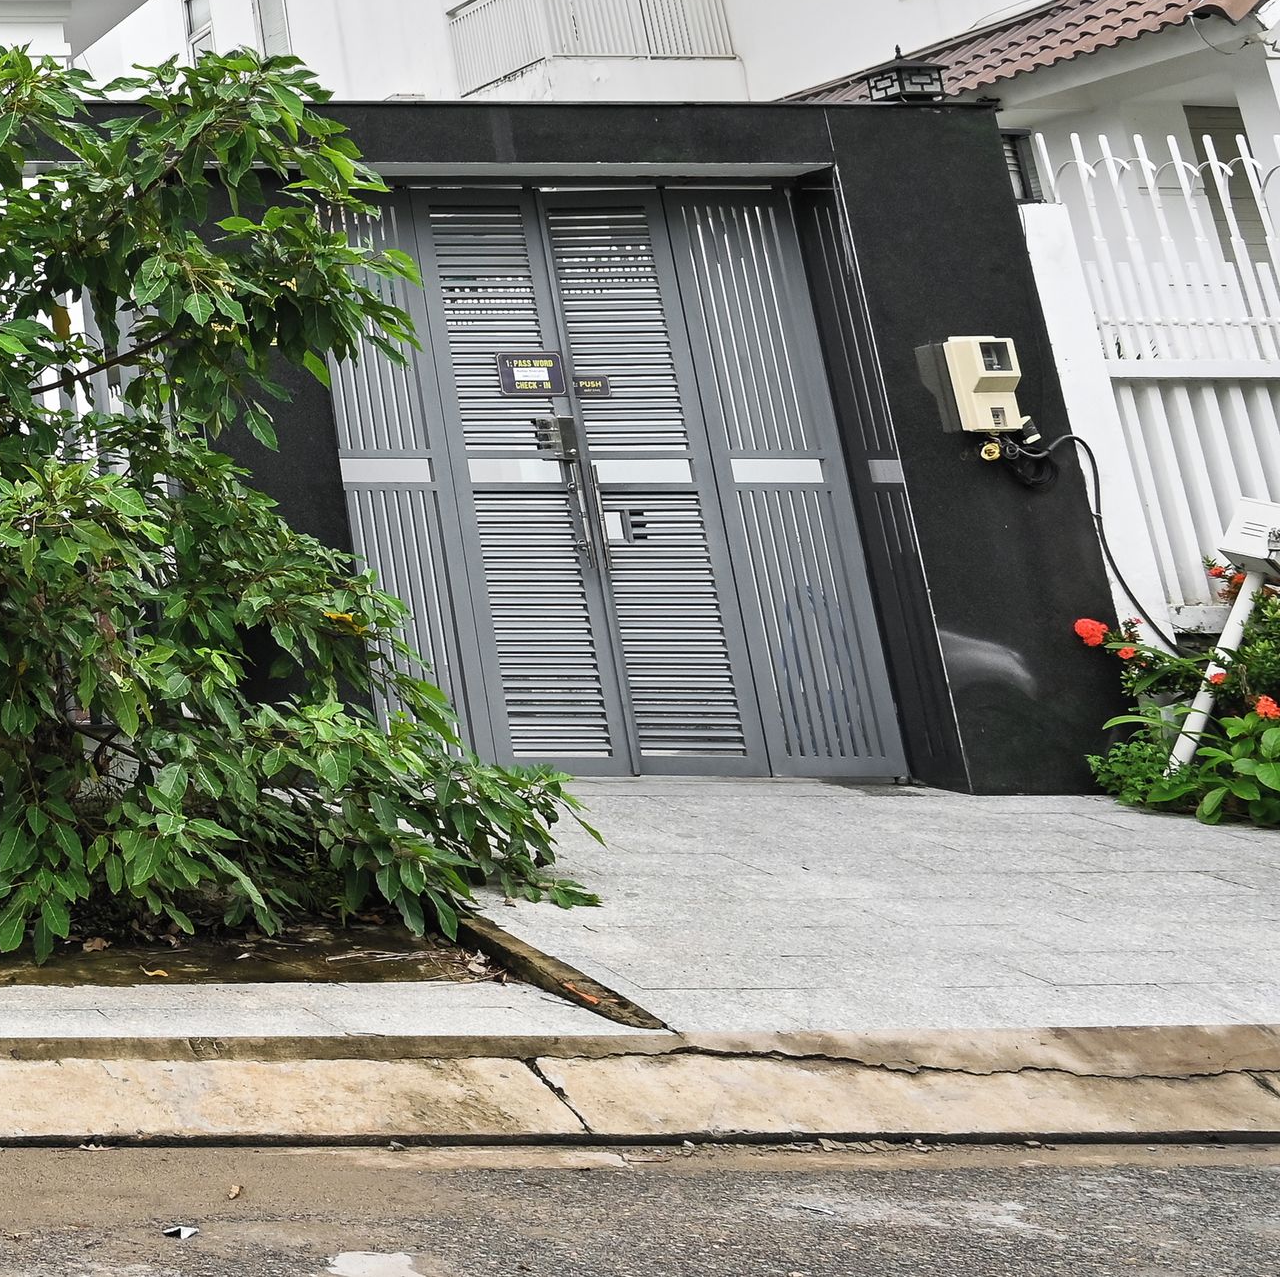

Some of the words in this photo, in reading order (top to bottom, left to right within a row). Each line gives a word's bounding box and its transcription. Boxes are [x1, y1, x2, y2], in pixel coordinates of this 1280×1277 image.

[513, 359, 531, 367] PASS
[532, 359, 554, 367] WORD
[515, 381, 537, 389] CHECK
[543, 381, 551, 389] IN
[579, 380, 602, 388] PUSH
